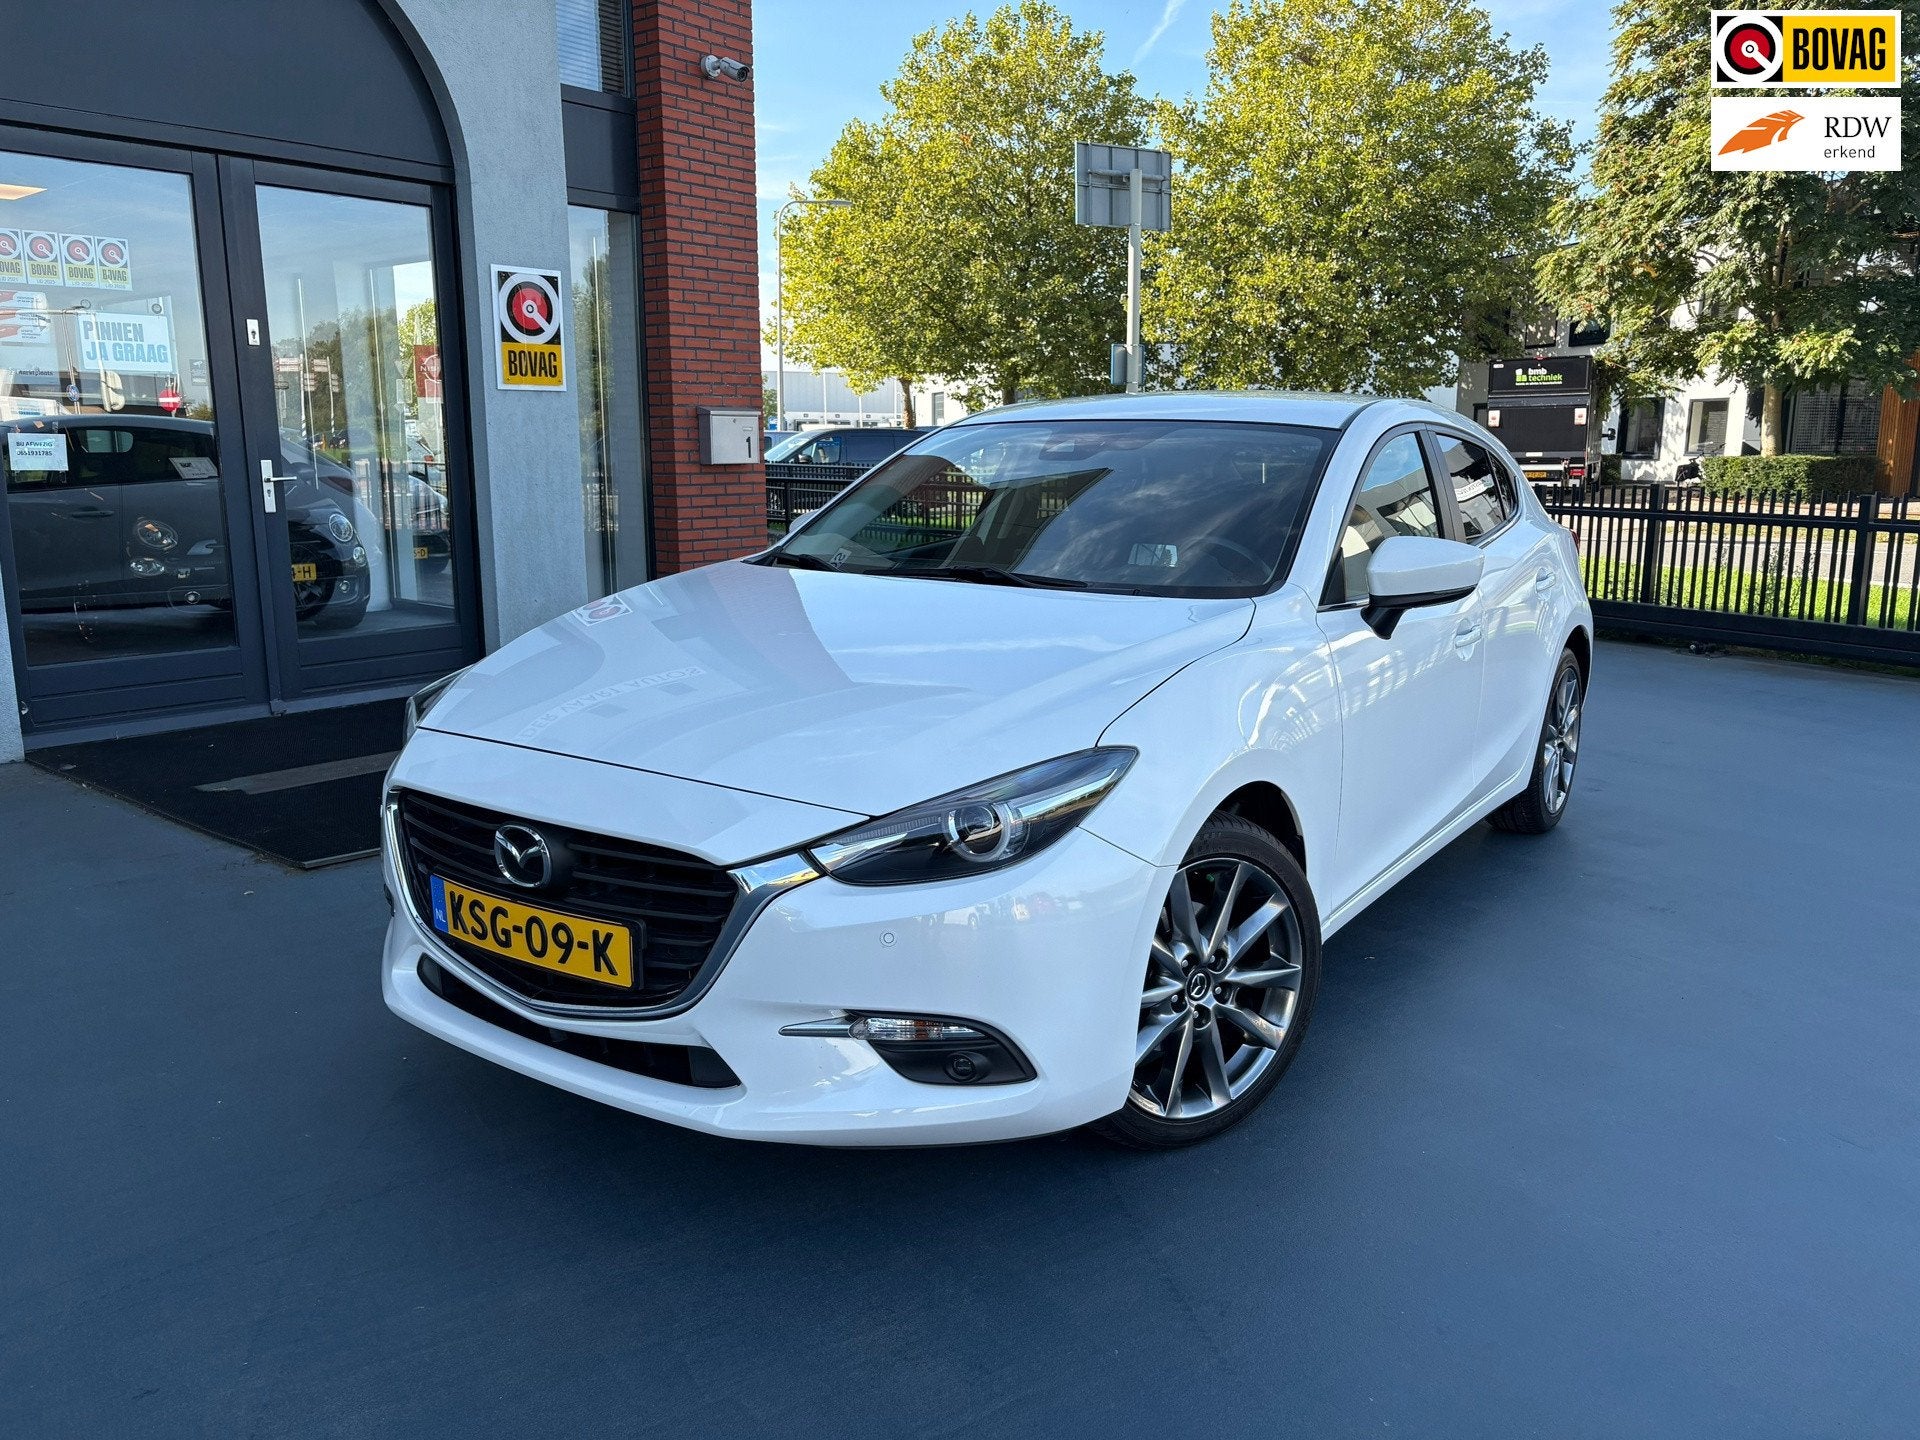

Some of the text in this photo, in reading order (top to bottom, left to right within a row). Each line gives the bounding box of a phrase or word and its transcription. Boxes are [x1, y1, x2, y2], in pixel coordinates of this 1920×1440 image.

[0, 260, 21, 273] OVAG
[31, 263, 57, 276] BOVAG
[68, 266, 94, 279] BOVAG
[83, 320, 145, 342] PINNEN
[112, 342, 169, 363] GRAAG
[507, 349, 557, 379] BOVAG
[1528, 367, 1547, 375] bmb
[1528, 373, 1563, 381] techniek
[745, 436, 752, 459] 1
[435, 909, 446, 922] NL
[449, 890, 619, 977] KSG-09-K
